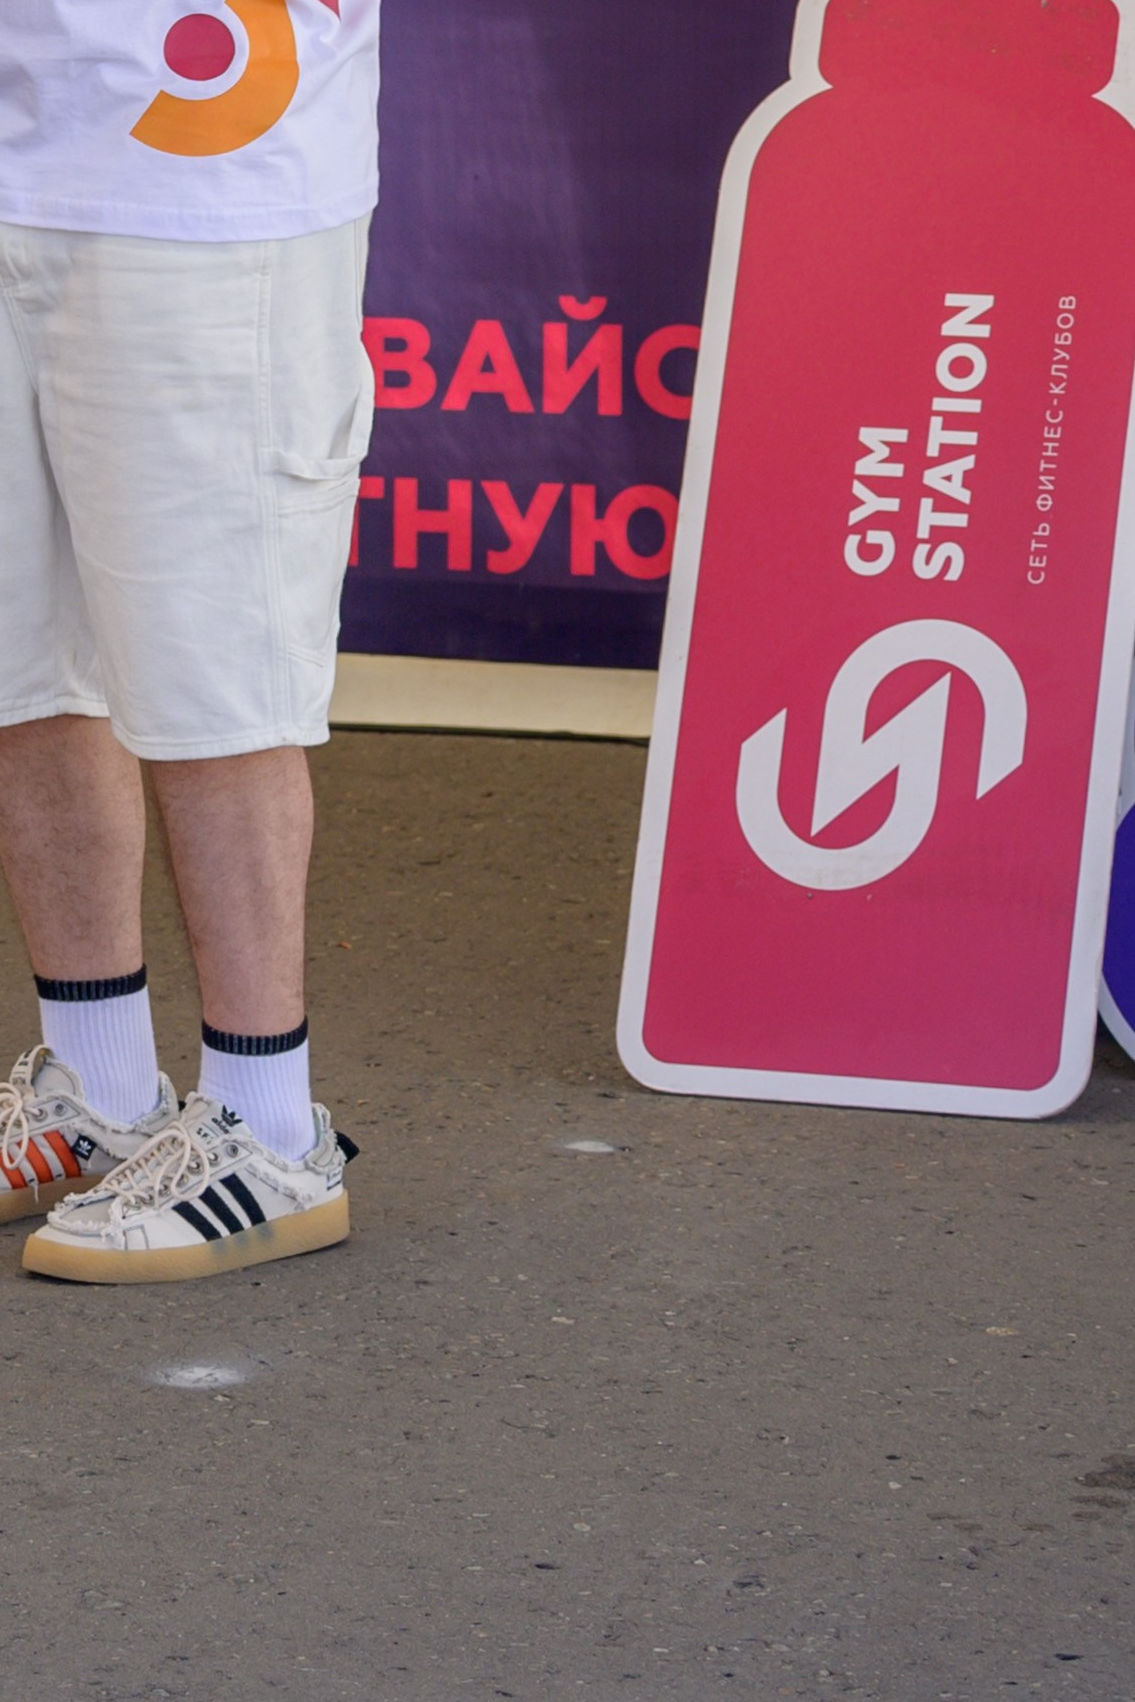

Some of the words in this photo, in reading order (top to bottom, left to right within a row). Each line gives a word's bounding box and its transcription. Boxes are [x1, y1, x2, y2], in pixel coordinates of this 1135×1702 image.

[912, 292, 995, 583] STATION
[1035, 294, 1077, 512] ФИТНЕС-КЛУБОВ
[843, 426, 909, 577] GYM
[1026, 521, 1051, 586] СЕТЬ
